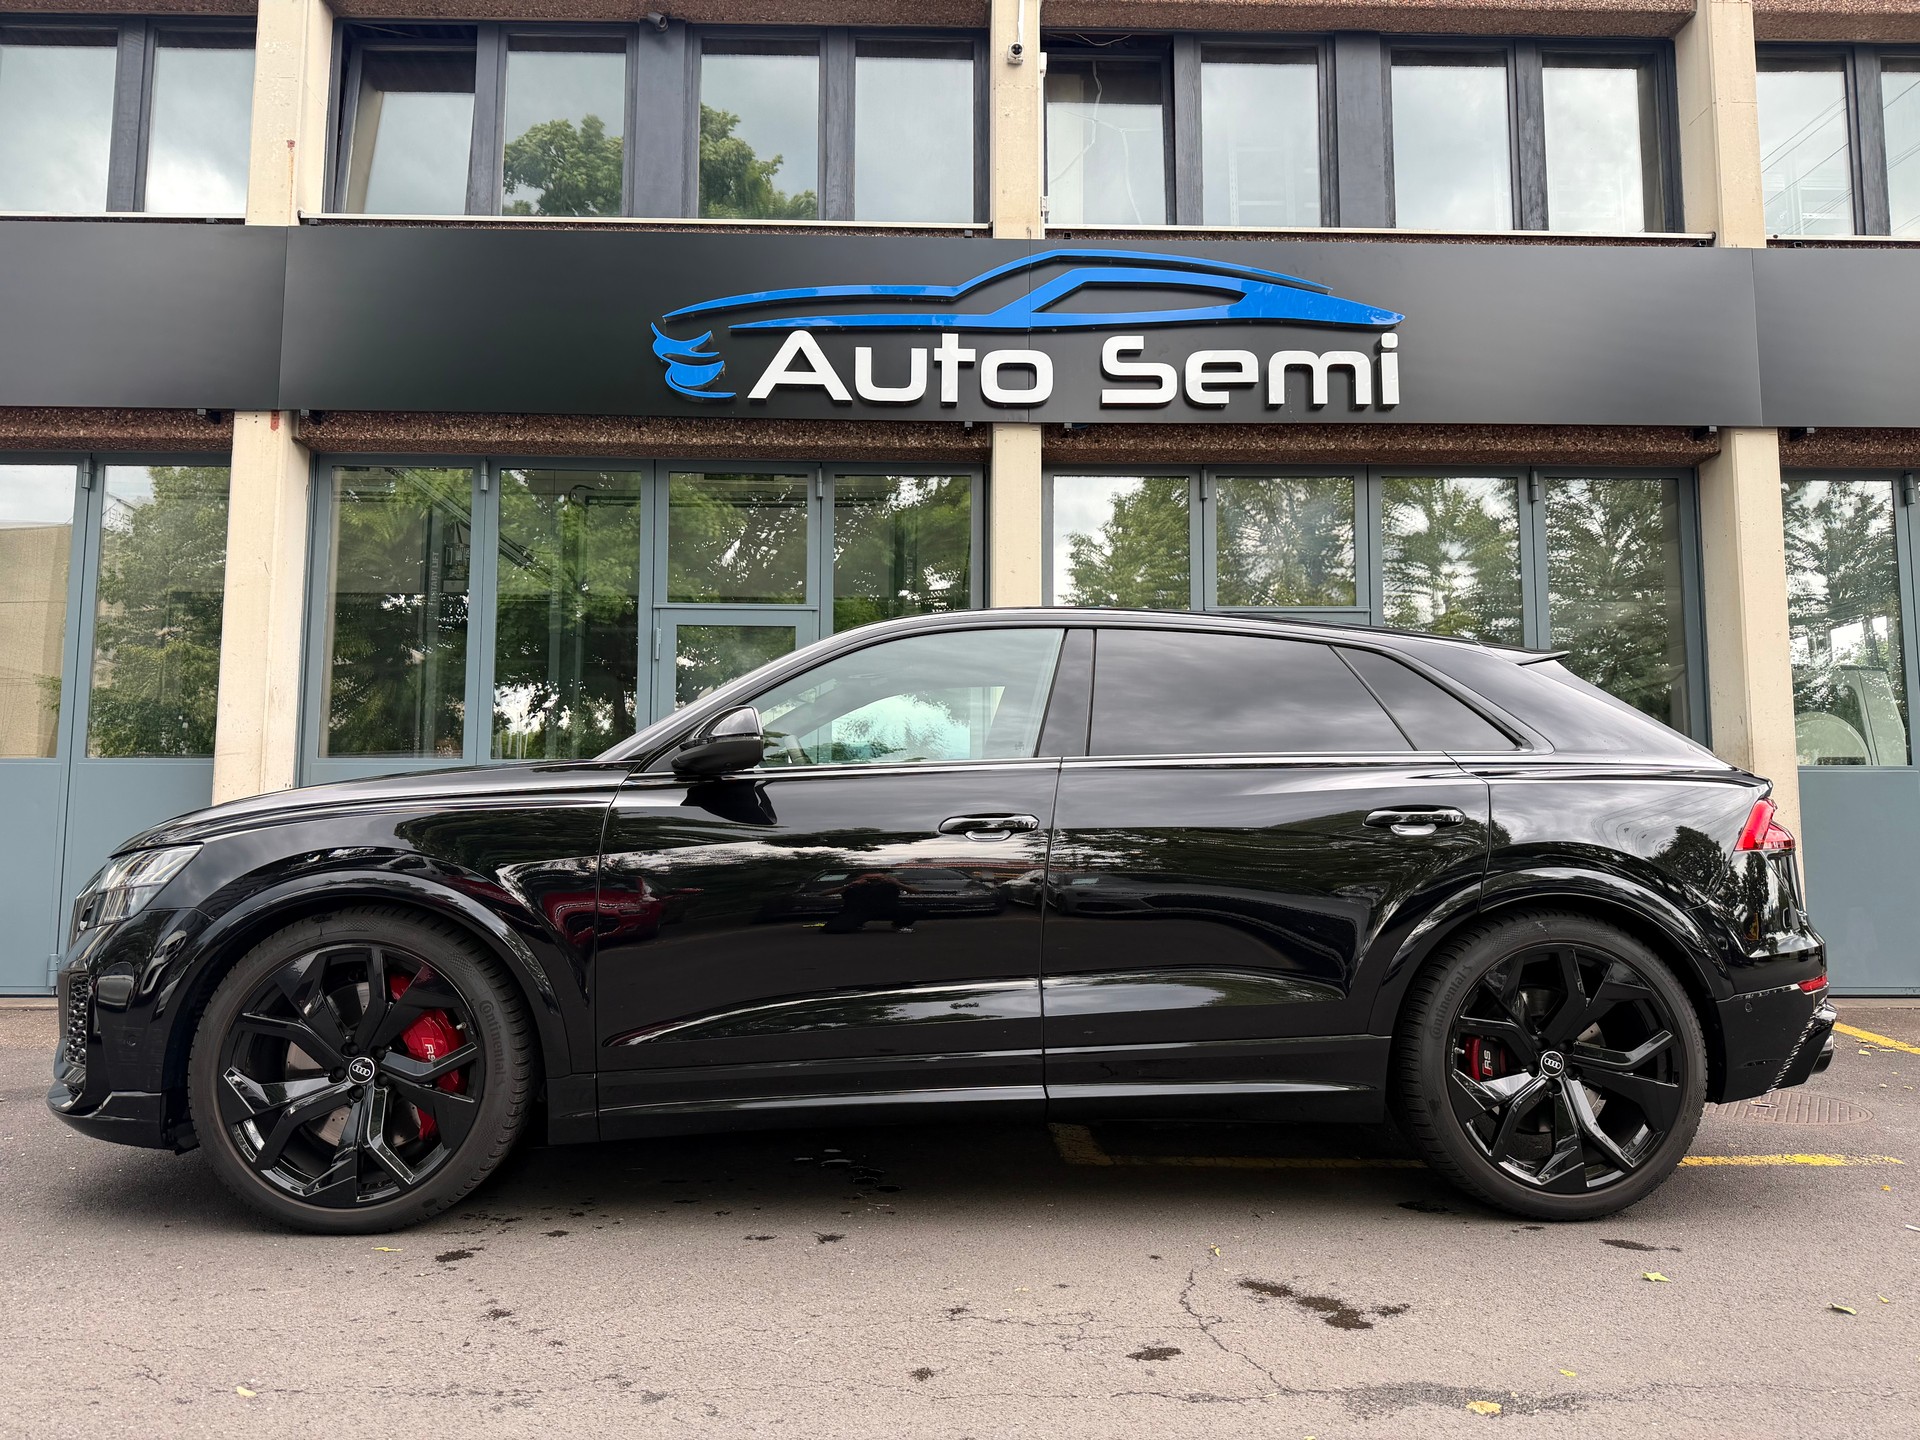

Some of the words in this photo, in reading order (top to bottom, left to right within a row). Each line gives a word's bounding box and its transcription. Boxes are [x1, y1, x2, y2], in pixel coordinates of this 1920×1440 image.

[746, 330, 1054, 404] Auto
[1101, 333, 1400, 408] Semi
[479, 1000, 507, 1075] Continental
[1430, 971, 1467, 1040] Continental
[424, 1044, 436, 1062] RS
[1483, 1050, 1493, 1070] RS
